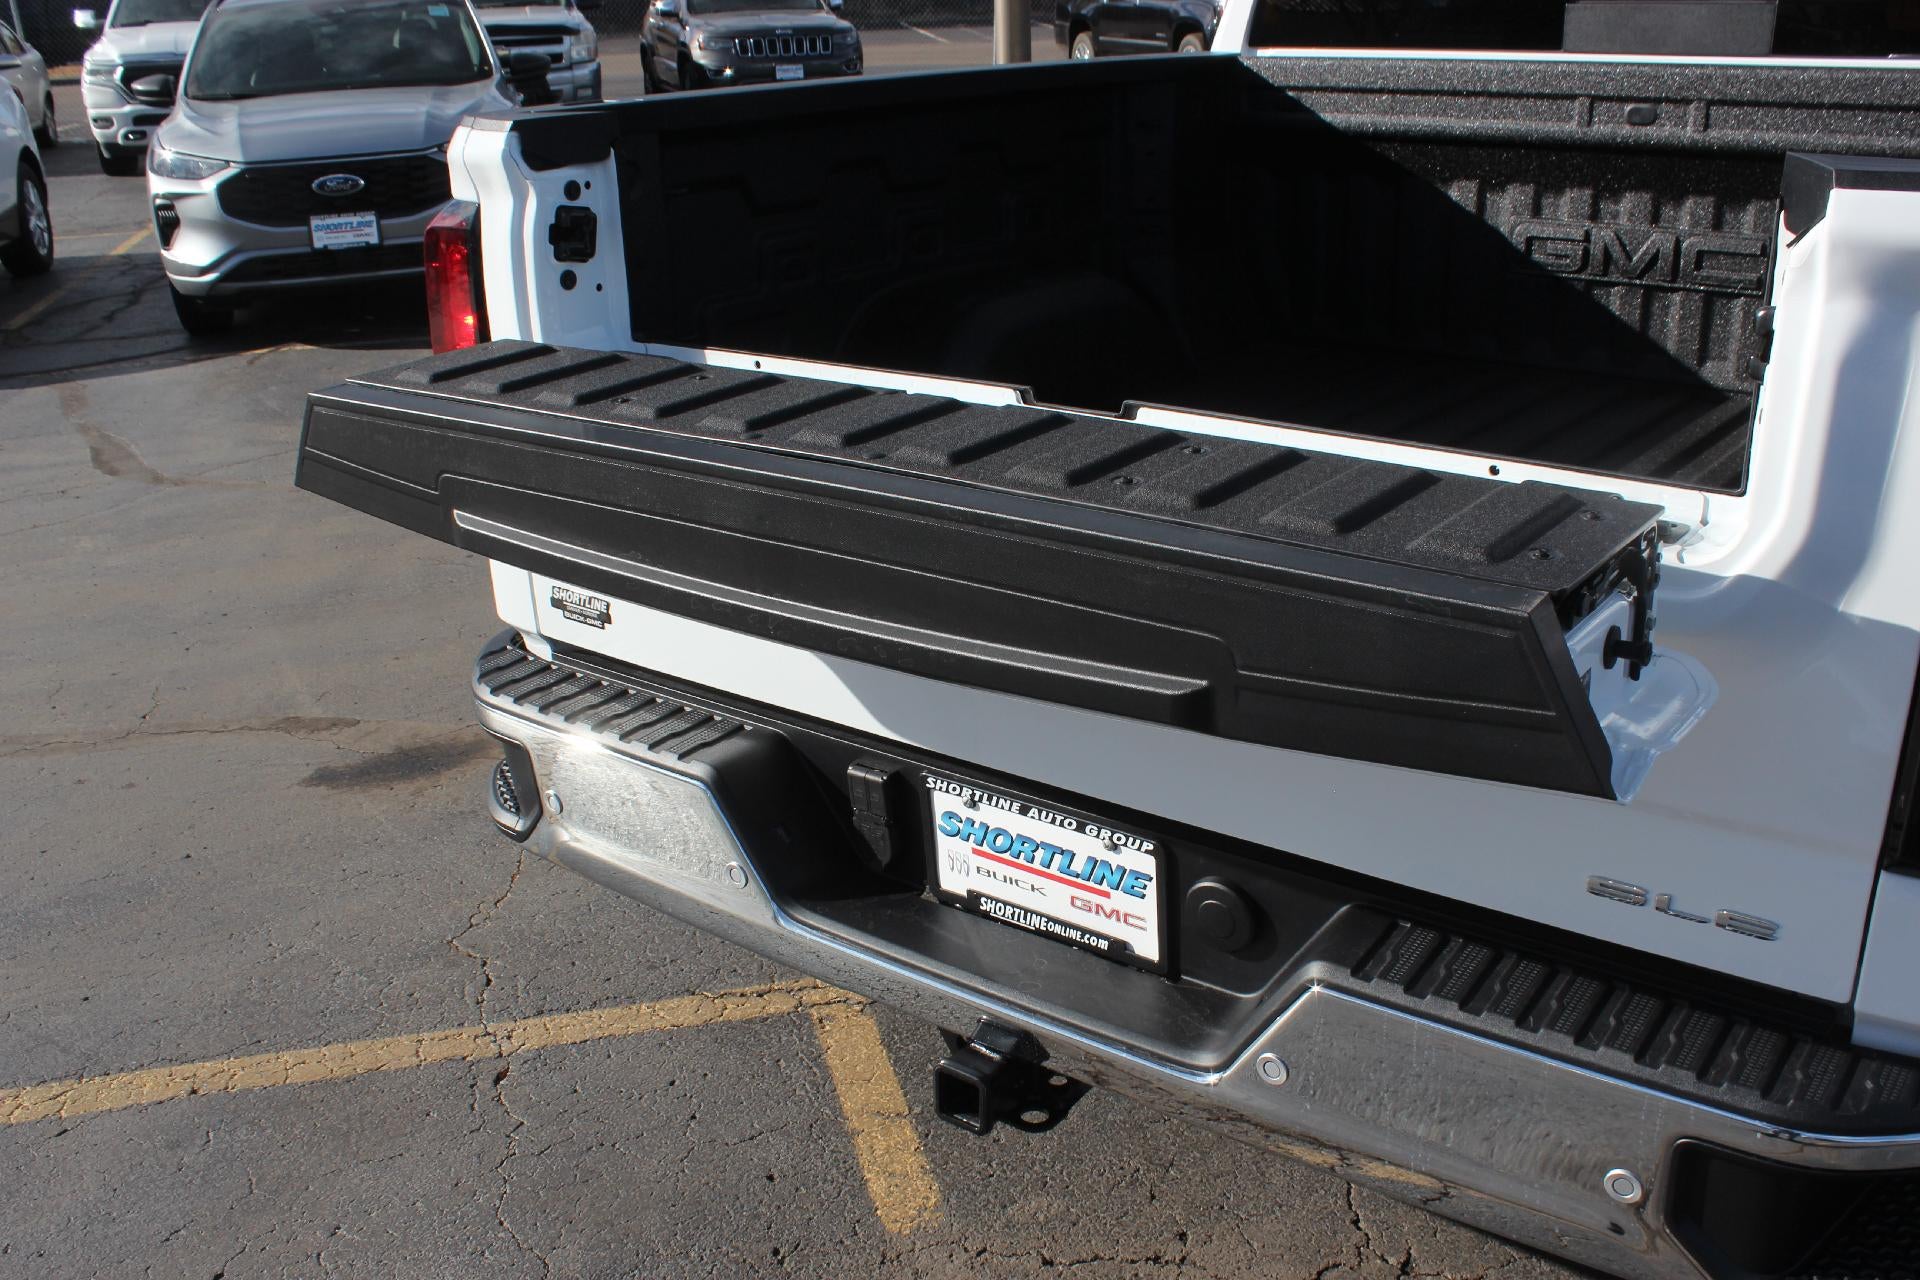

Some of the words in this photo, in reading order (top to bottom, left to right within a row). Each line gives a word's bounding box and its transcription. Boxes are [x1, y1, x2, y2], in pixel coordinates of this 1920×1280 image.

[1514, 222, 1767, 290] GMC
[553, 587, 608, 613] SHORTLINE
[926, 777, 1021, 814] SHORTLINE
[1027, 807, 1077, 830] AUTO
[1085, 825, 1154, 852] GROUP
[938, 811, 1153, 899] SHORTLINE
[976, 866, 1047, 896] BUICK
[1070, 896, 1148, 931] GMC
[1587, 875, 1780, 942] SLE
